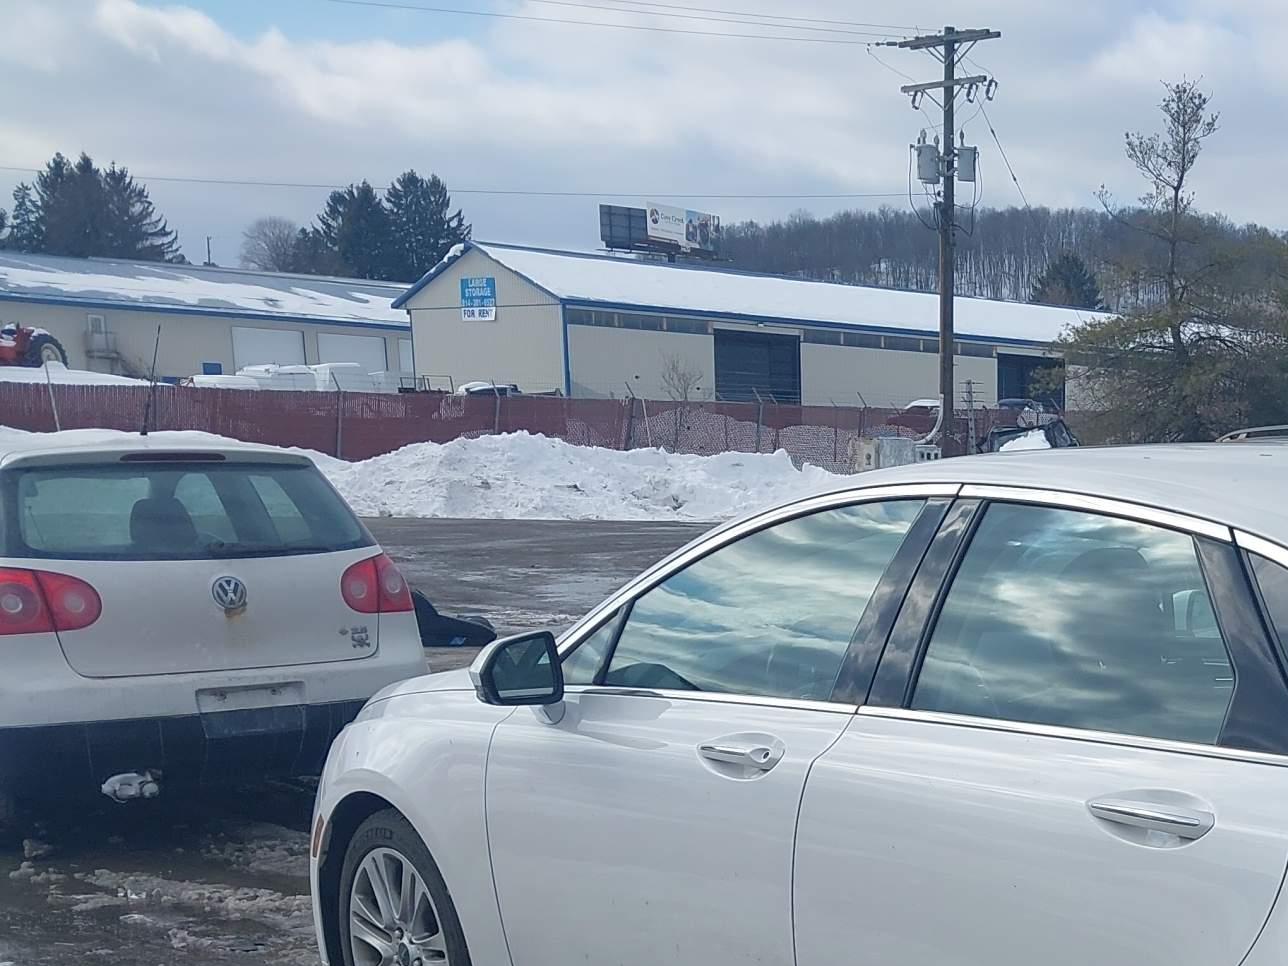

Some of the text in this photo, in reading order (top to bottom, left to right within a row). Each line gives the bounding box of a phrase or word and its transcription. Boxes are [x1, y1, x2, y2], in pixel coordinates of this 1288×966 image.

[468, 279, 487, 287] LARGE
[465, 288, 491, 297] STORAGE
[463, 309, 493, 318] FOR RENT
